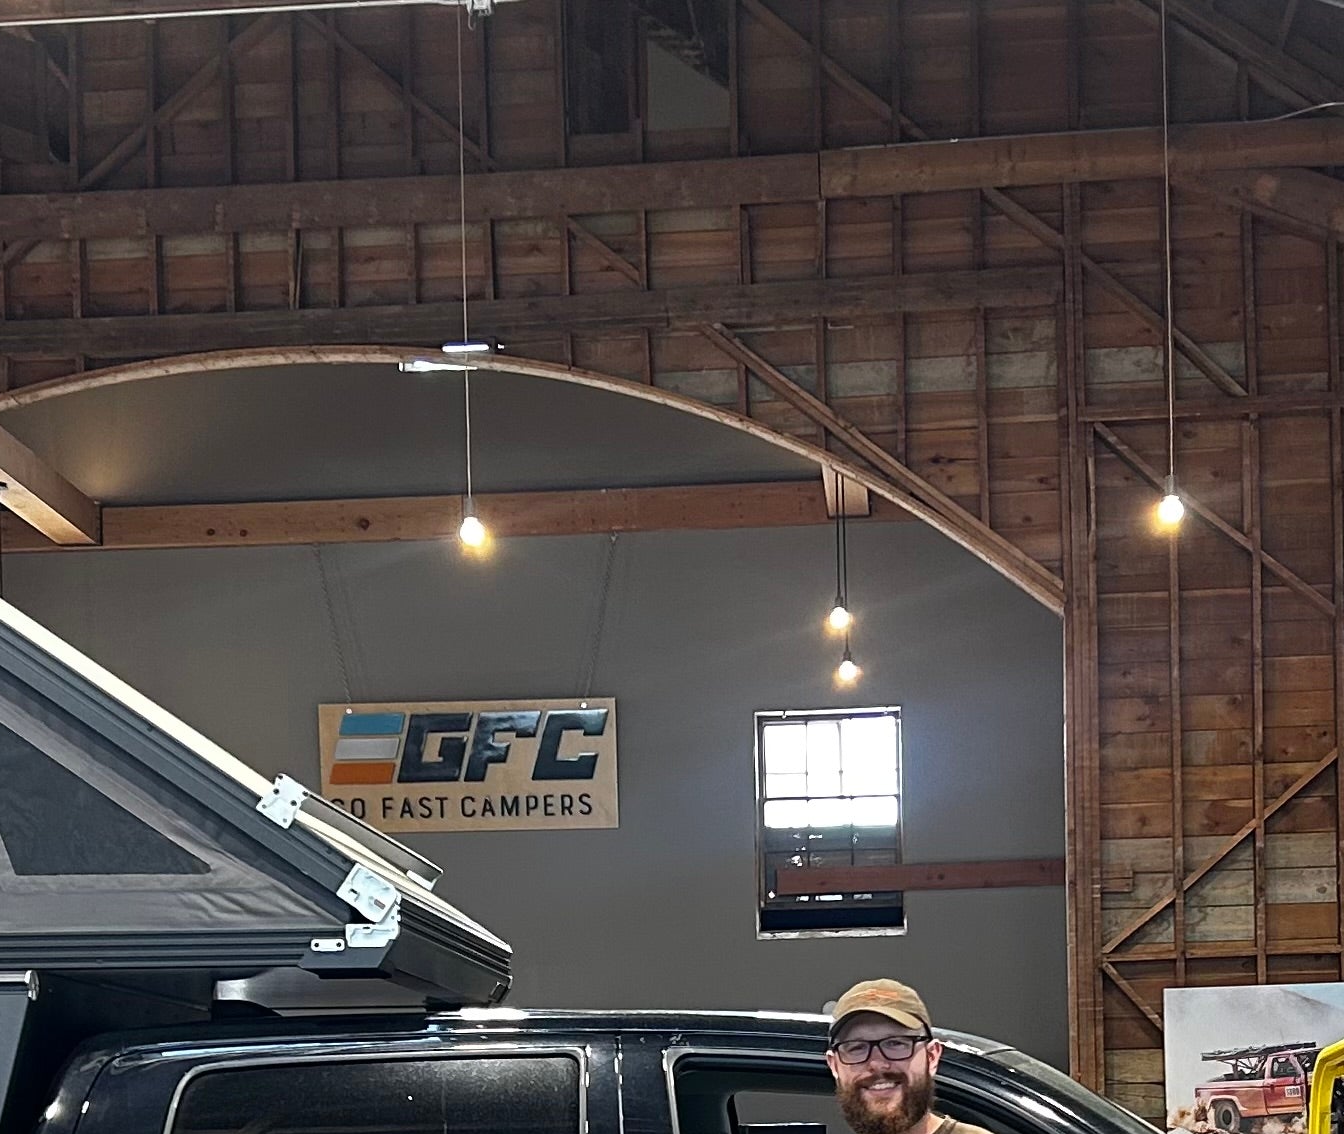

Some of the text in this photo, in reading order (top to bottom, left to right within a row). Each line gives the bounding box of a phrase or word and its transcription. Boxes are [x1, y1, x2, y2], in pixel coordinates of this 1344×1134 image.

[397, 708, 609, 783] GFC
[382, 796, 449, 819] FAST
[460, 793, 593, 818] CAMPERS
